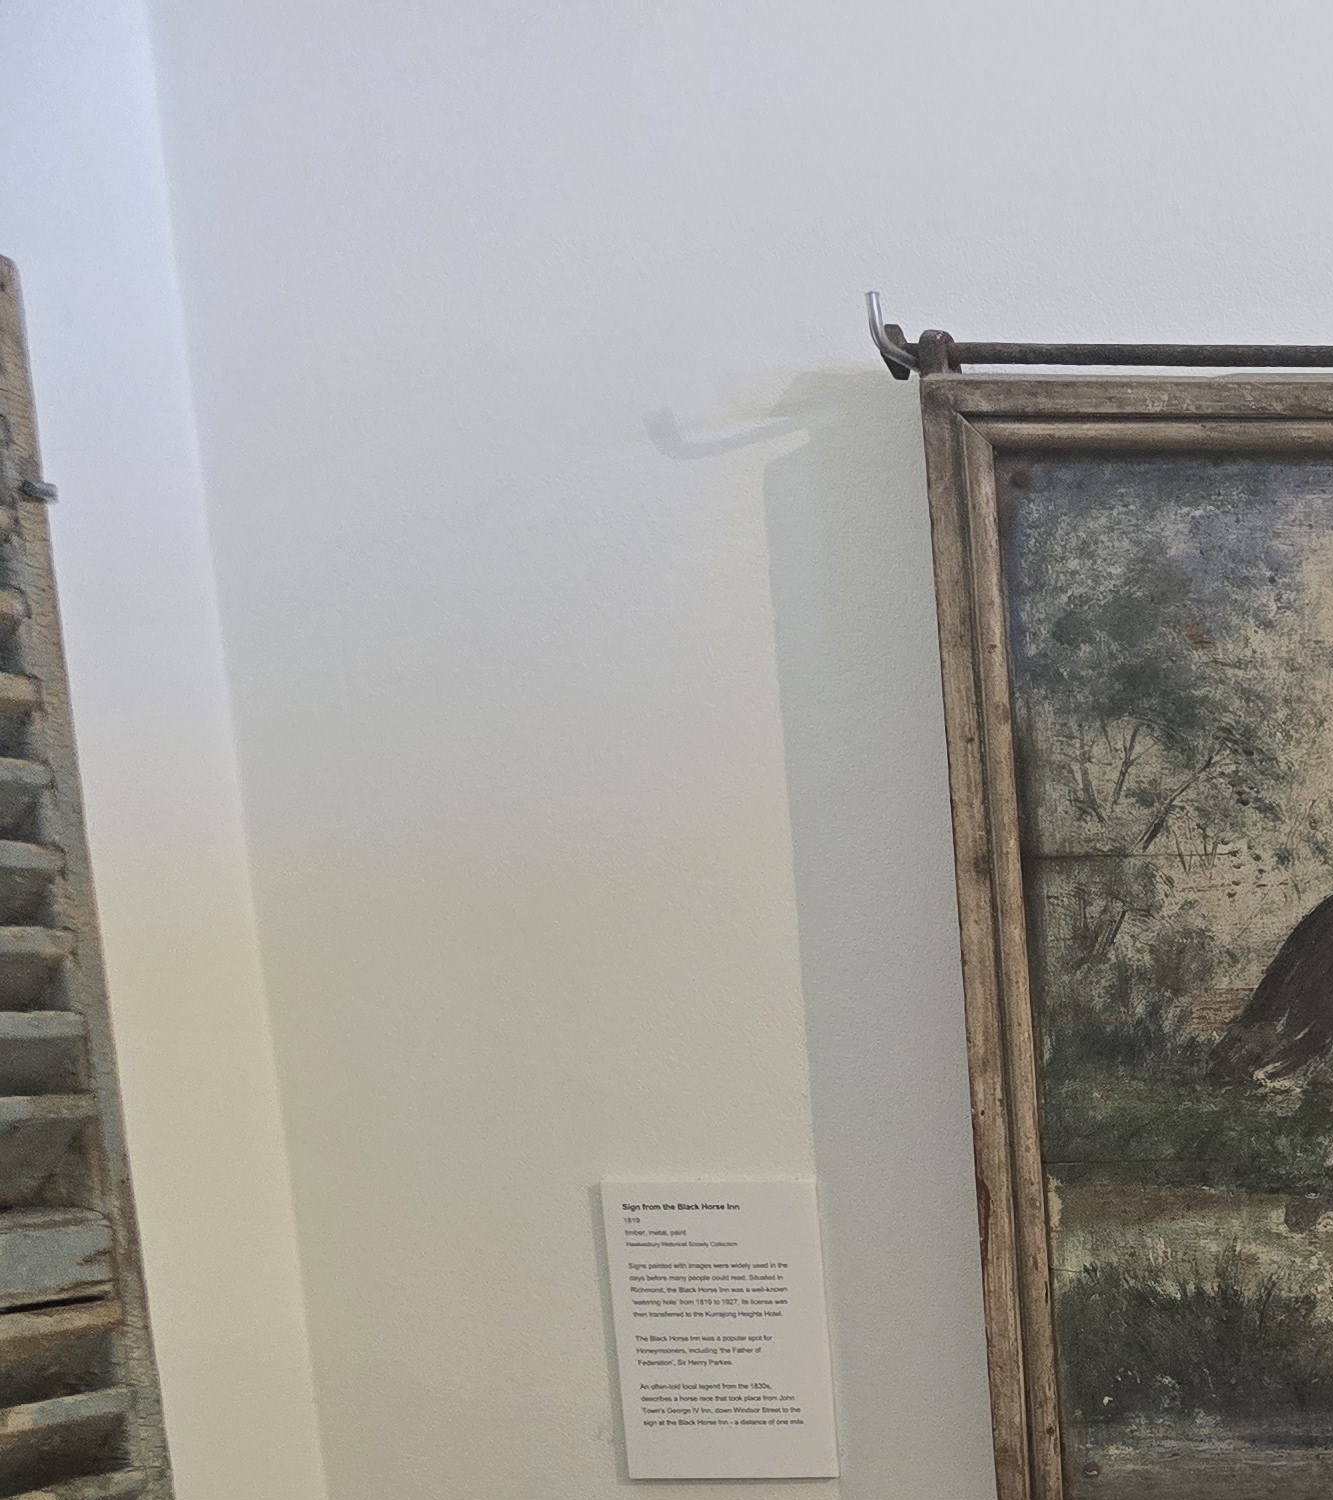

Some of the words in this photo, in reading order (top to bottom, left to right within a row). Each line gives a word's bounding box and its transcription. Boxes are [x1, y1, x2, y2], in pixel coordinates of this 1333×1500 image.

[622, 1202, 640, 1212] Sign
[642, 1202, 661, 1211] from
[662, 1202, 675, 1211] the
[677, 1202, 699, 1211] Black
[701, 1202, 724, 1211] Horse
[726, 1202, 739, 1211] Inn
